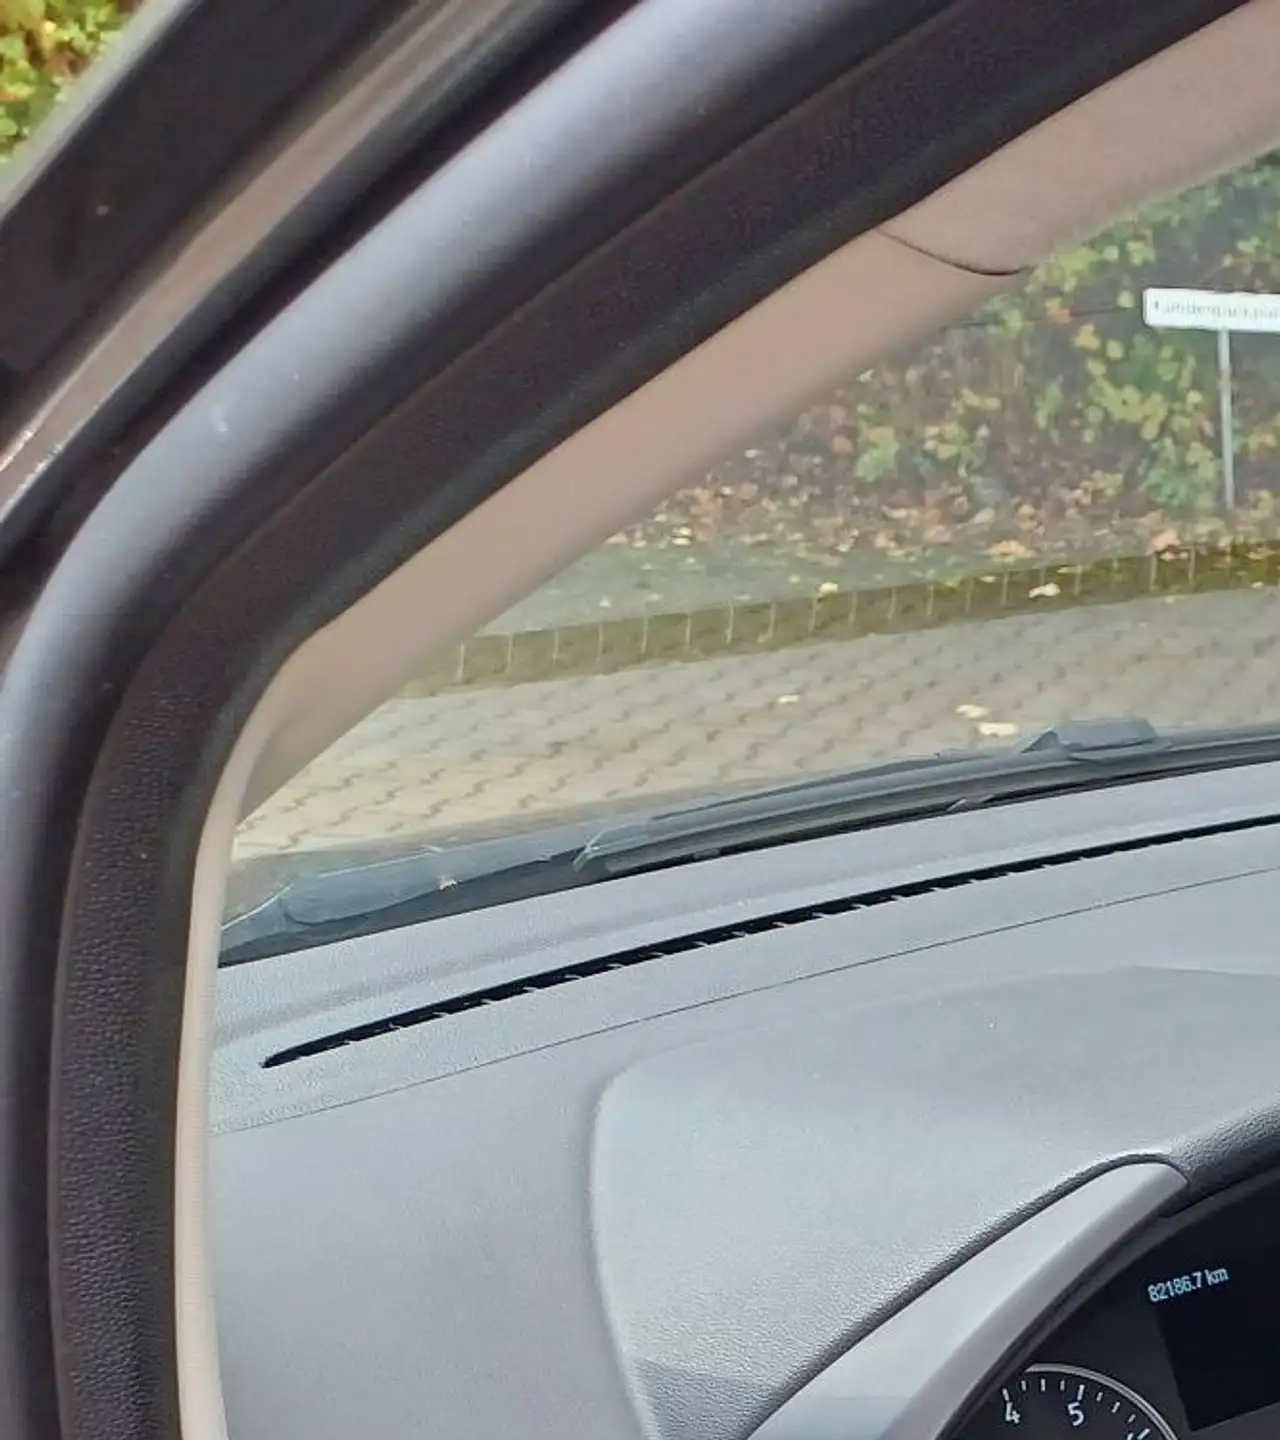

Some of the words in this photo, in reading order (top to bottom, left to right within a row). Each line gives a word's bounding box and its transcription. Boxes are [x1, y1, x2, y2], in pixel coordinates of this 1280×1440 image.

[1147, 1271, 1202, 1303] 82186.7
[1204, 1268, 1229, 1286] km
[1004, 1402, 1021, 1425] 4
[1067, 1401, 1085, 1426] 5
